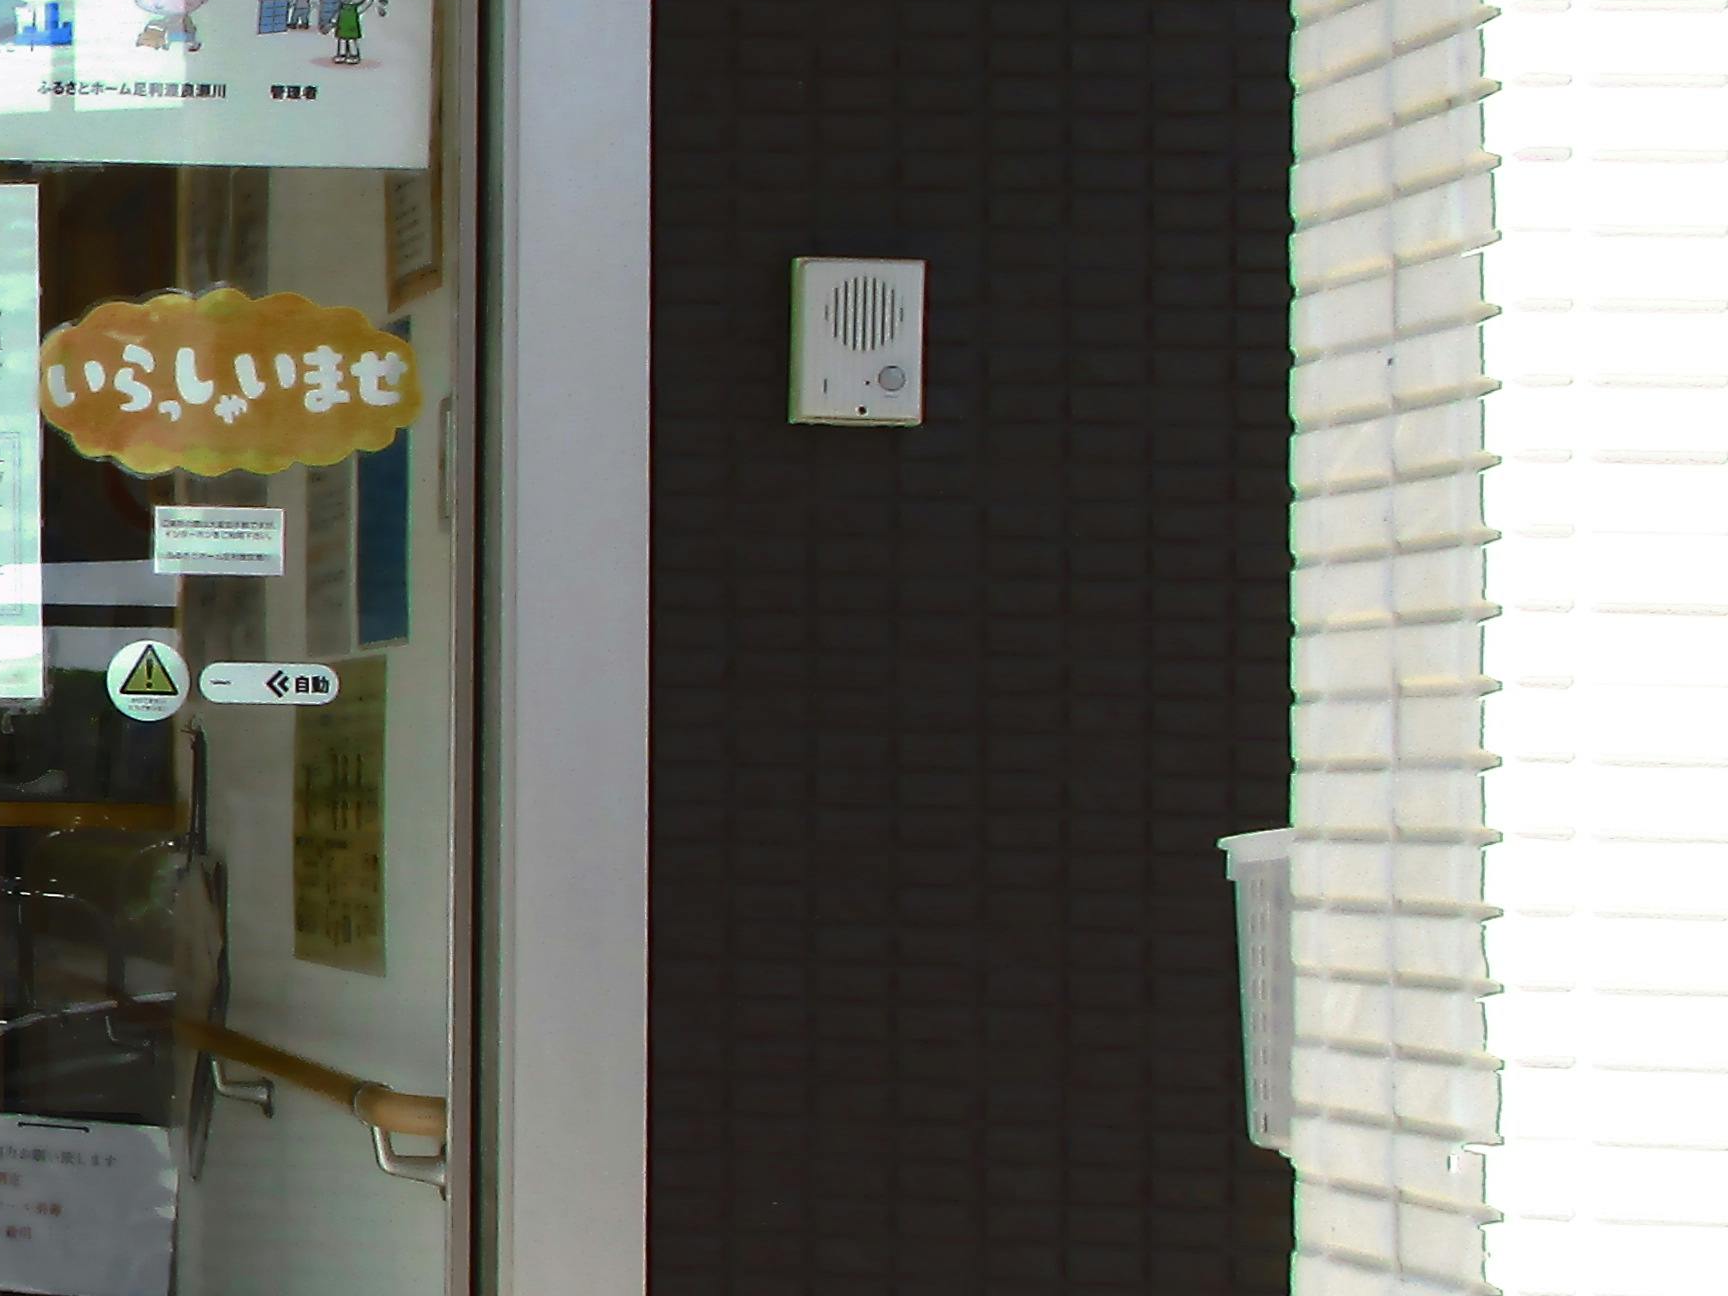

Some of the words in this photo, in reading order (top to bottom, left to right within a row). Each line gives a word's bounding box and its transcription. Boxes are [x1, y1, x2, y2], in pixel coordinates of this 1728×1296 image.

[47, 343, 408, 424] いらっしゃいませ
[294, 674, 330, 694] 自動
